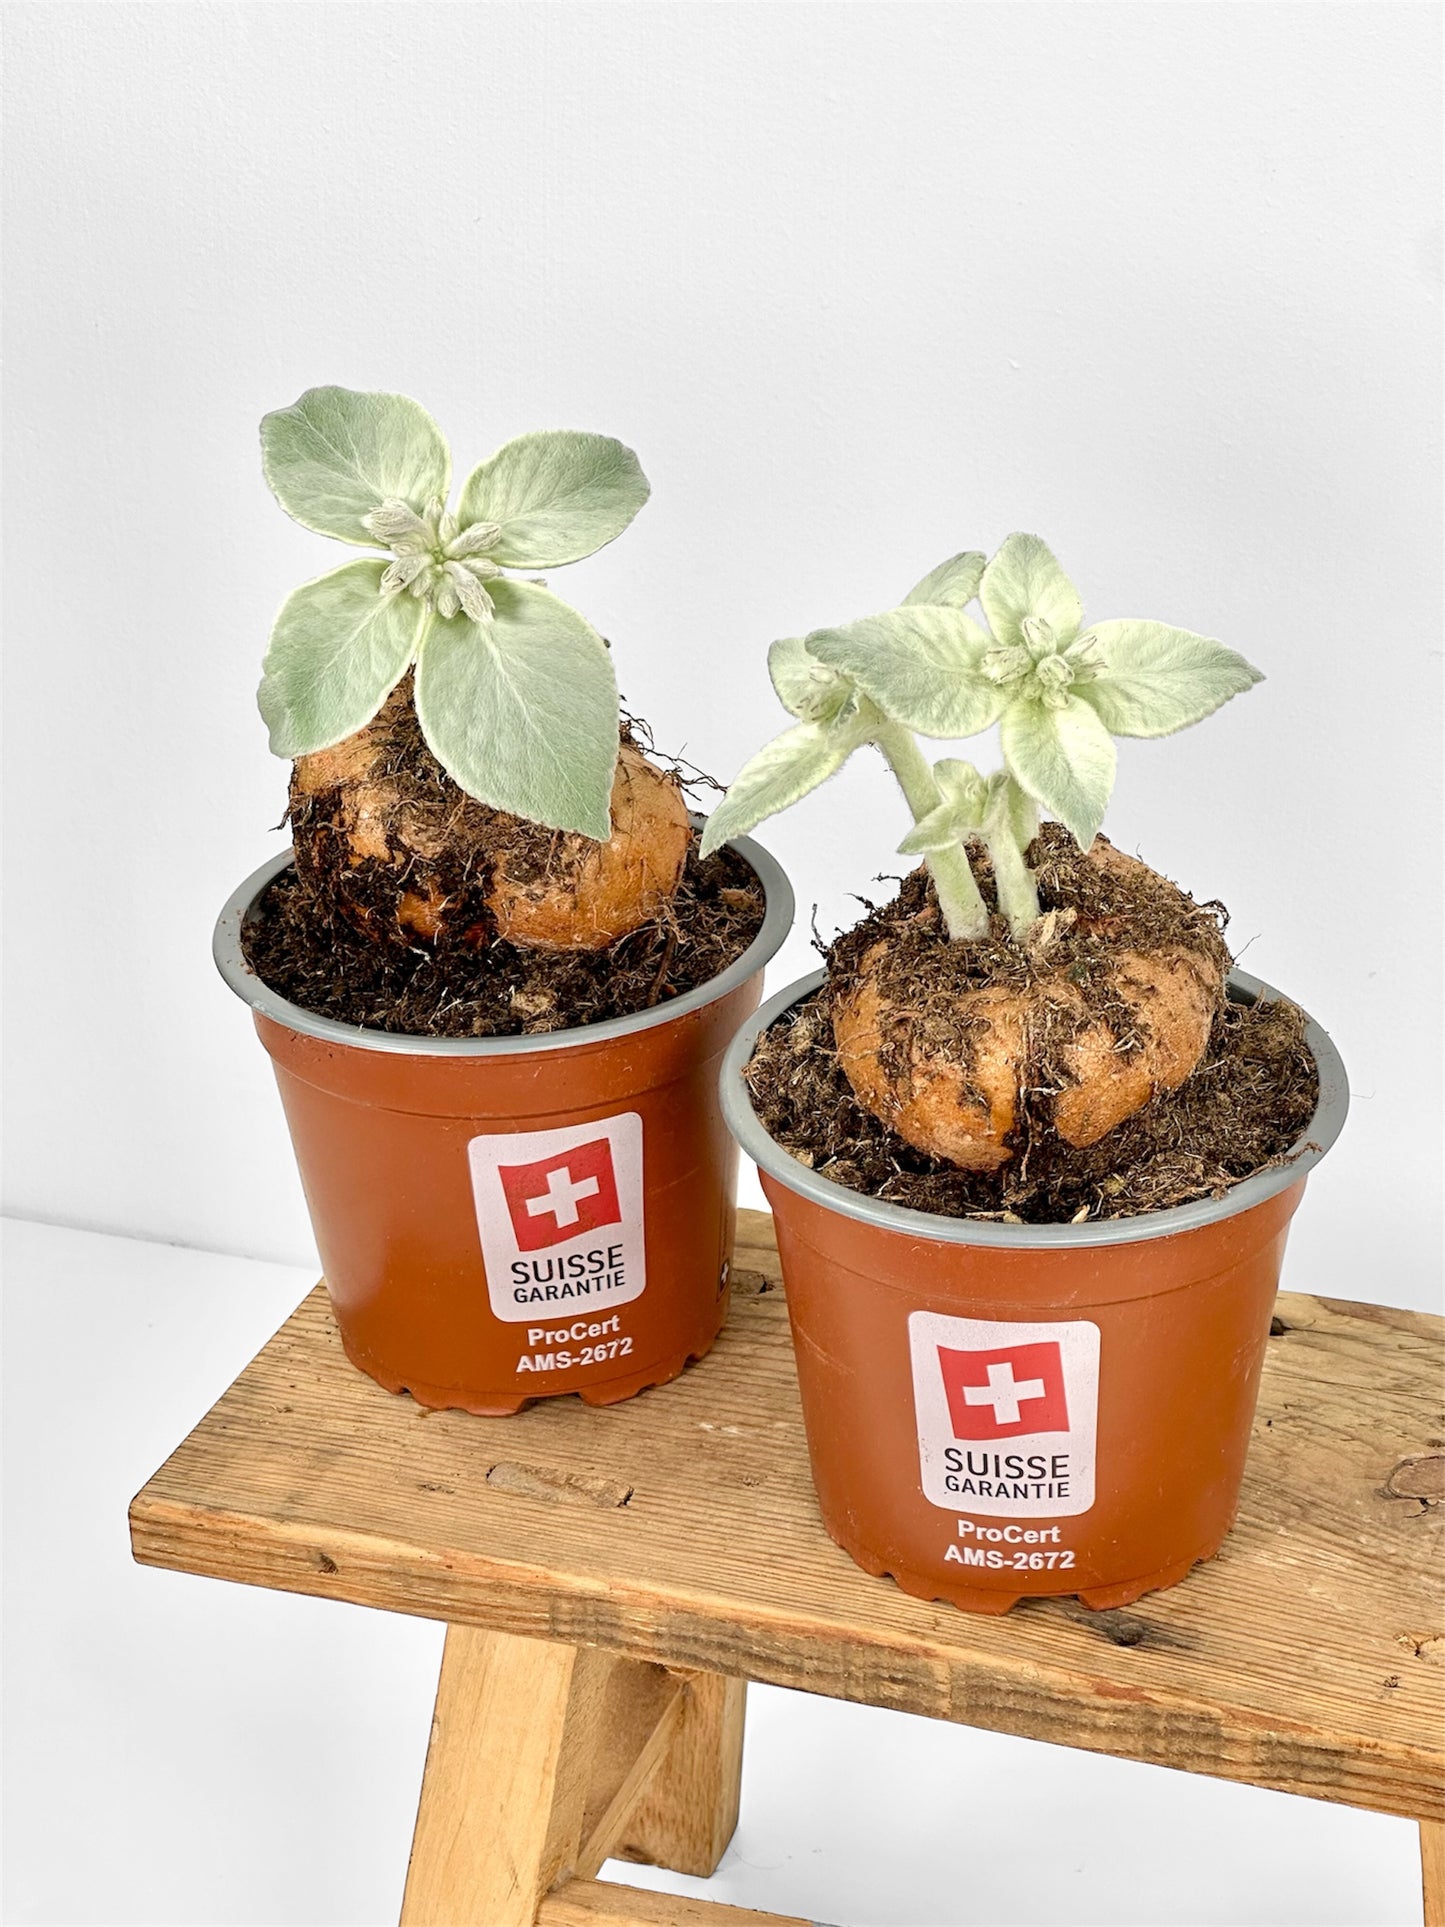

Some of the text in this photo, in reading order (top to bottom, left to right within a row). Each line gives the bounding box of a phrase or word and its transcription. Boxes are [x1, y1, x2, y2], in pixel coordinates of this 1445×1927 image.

[511, 1243, 625, 1285] SUISSE
[513, 1269, 626, 1304] GARANTIE
[527, 1315, 620, 1346] ProCert
[516, 1337, 634, 1373] AMS-2672
[944, 1447, 1070, 1480] SUISSE
[945, 1475, 1070, 1499] GARANTIE
[957, 1519, 1061, 1544] ProCert
[944, 1544, 1076, 1571] AMS-2672
